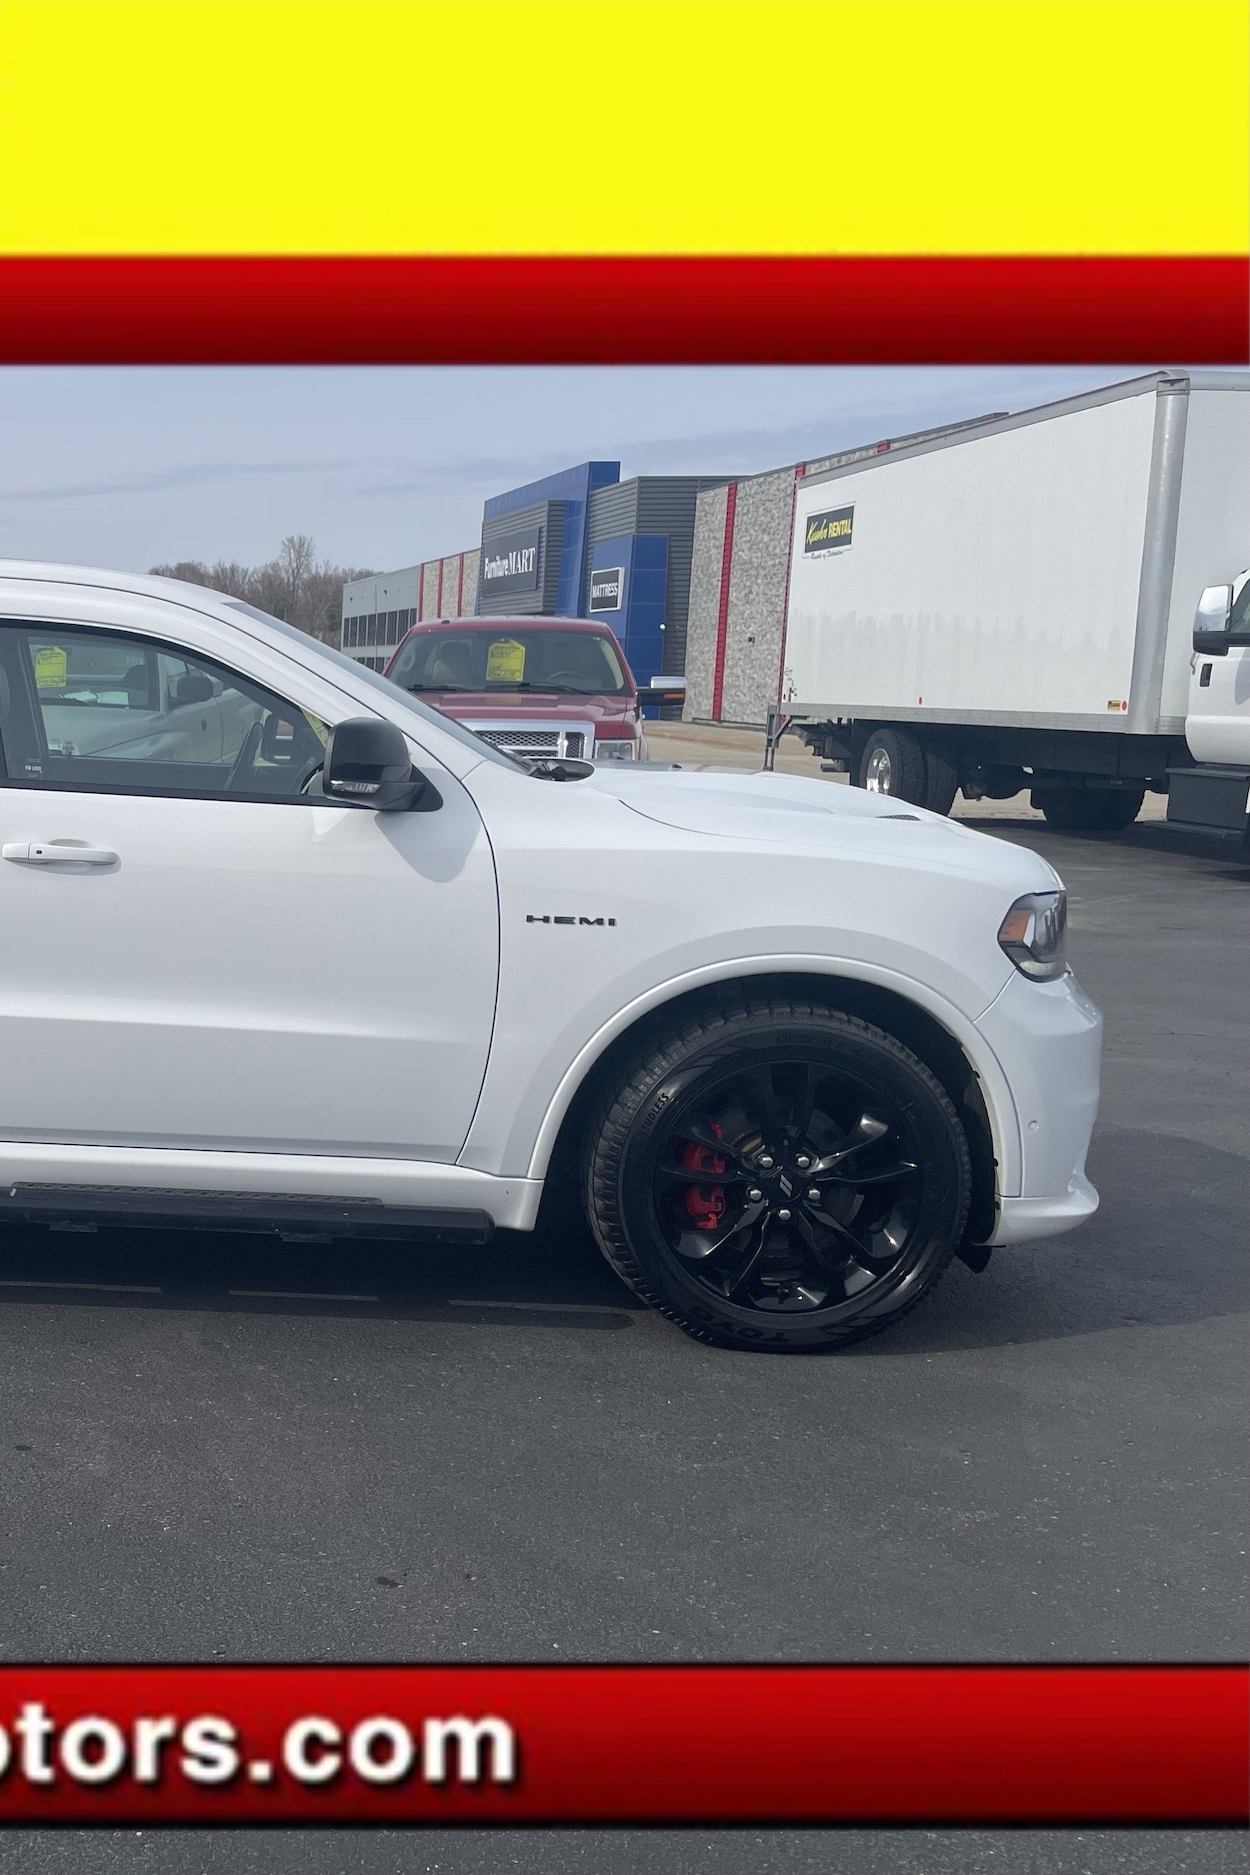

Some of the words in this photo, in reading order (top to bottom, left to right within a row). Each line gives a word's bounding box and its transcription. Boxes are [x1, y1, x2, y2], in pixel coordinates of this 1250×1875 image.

[807, 518, 828, 545] Kuehn
[828, 519, 851, 538] RENTAL
[592, 582, 618, 598] MATTRESS
[526, 914, 617, 927] HEMI
[639, 1092, 669, 1134] STUDLESS
